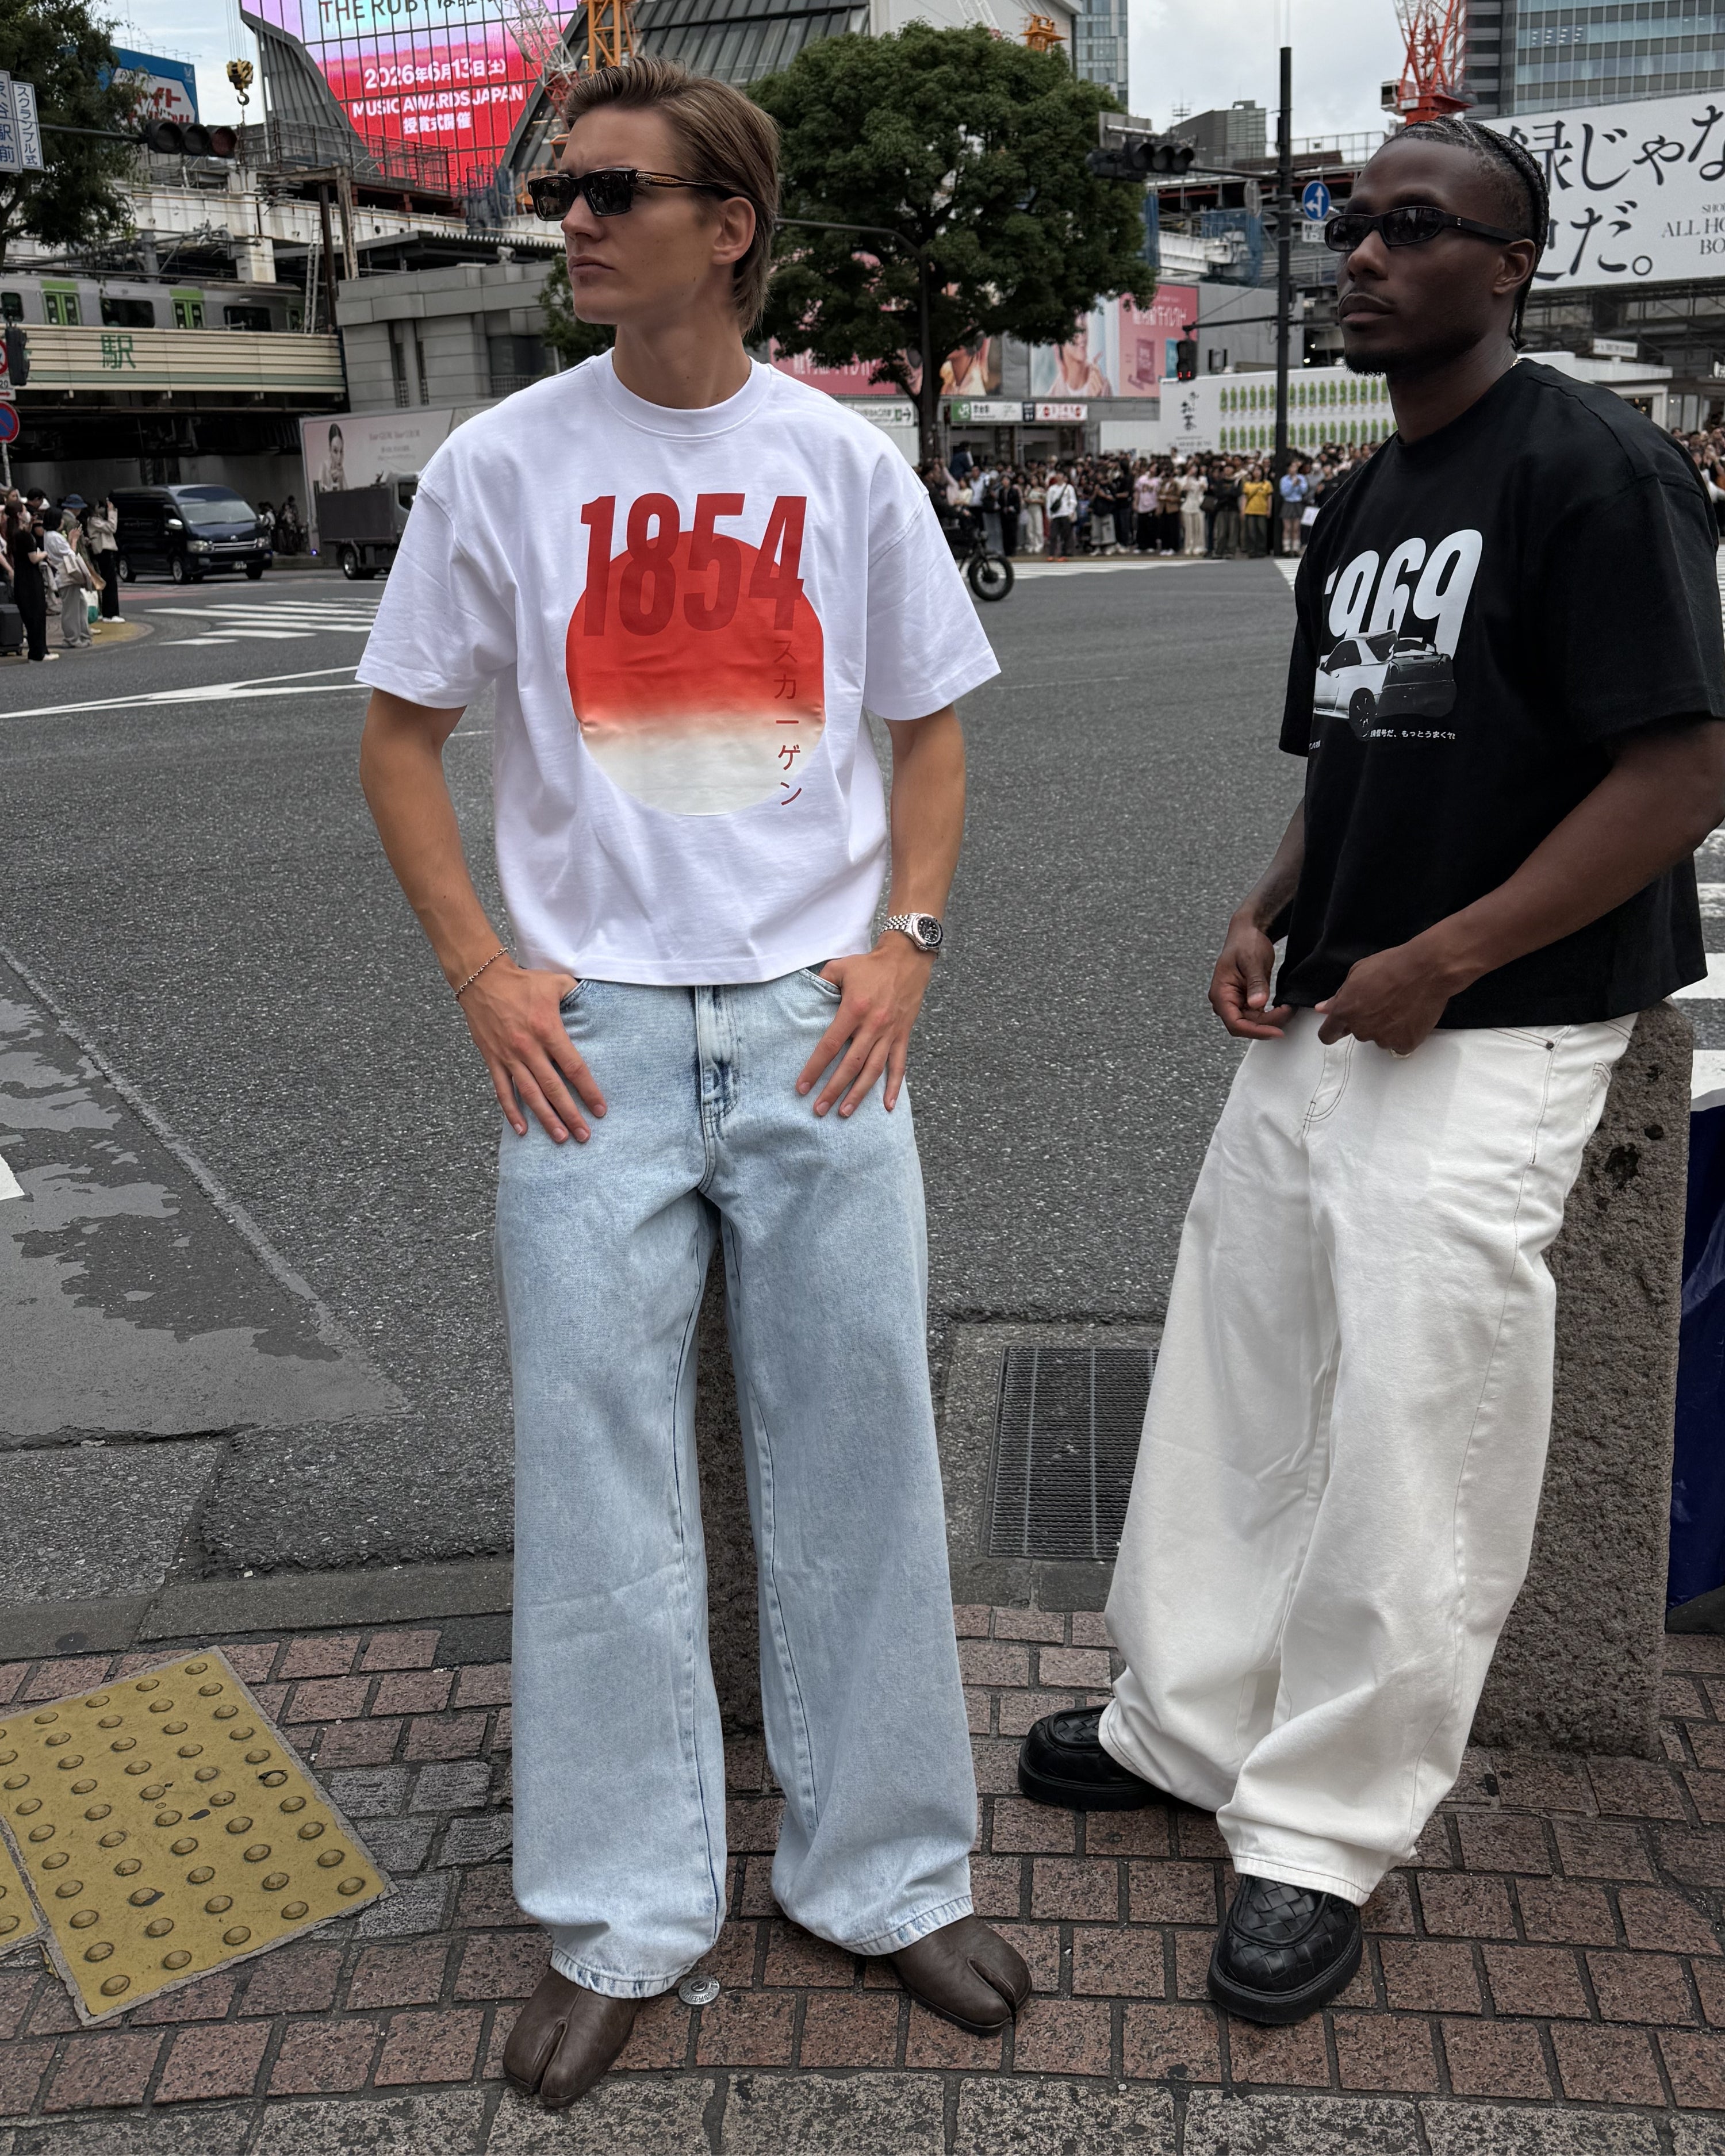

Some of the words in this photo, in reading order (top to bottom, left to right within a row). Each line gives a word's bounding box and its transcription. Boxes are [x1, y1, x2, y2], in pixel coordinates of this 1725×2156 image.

[320, 0, 365, 22] THE
[364, 58, 506, 89] 2026年6月13日(土)
[352, 98, 400, 118] MUSIC
[403, 90, 470, 113] AWARDS
[472, 85, 523, 106] JAPAN
[1662, 220, 1700, 238] ALL
[101, 334, 137, 369] 駅
[581, 493, 807, 636] 1854
[1324, 529, 1483, 660] 969
[773, 639, 802, 806] スカーゲン
